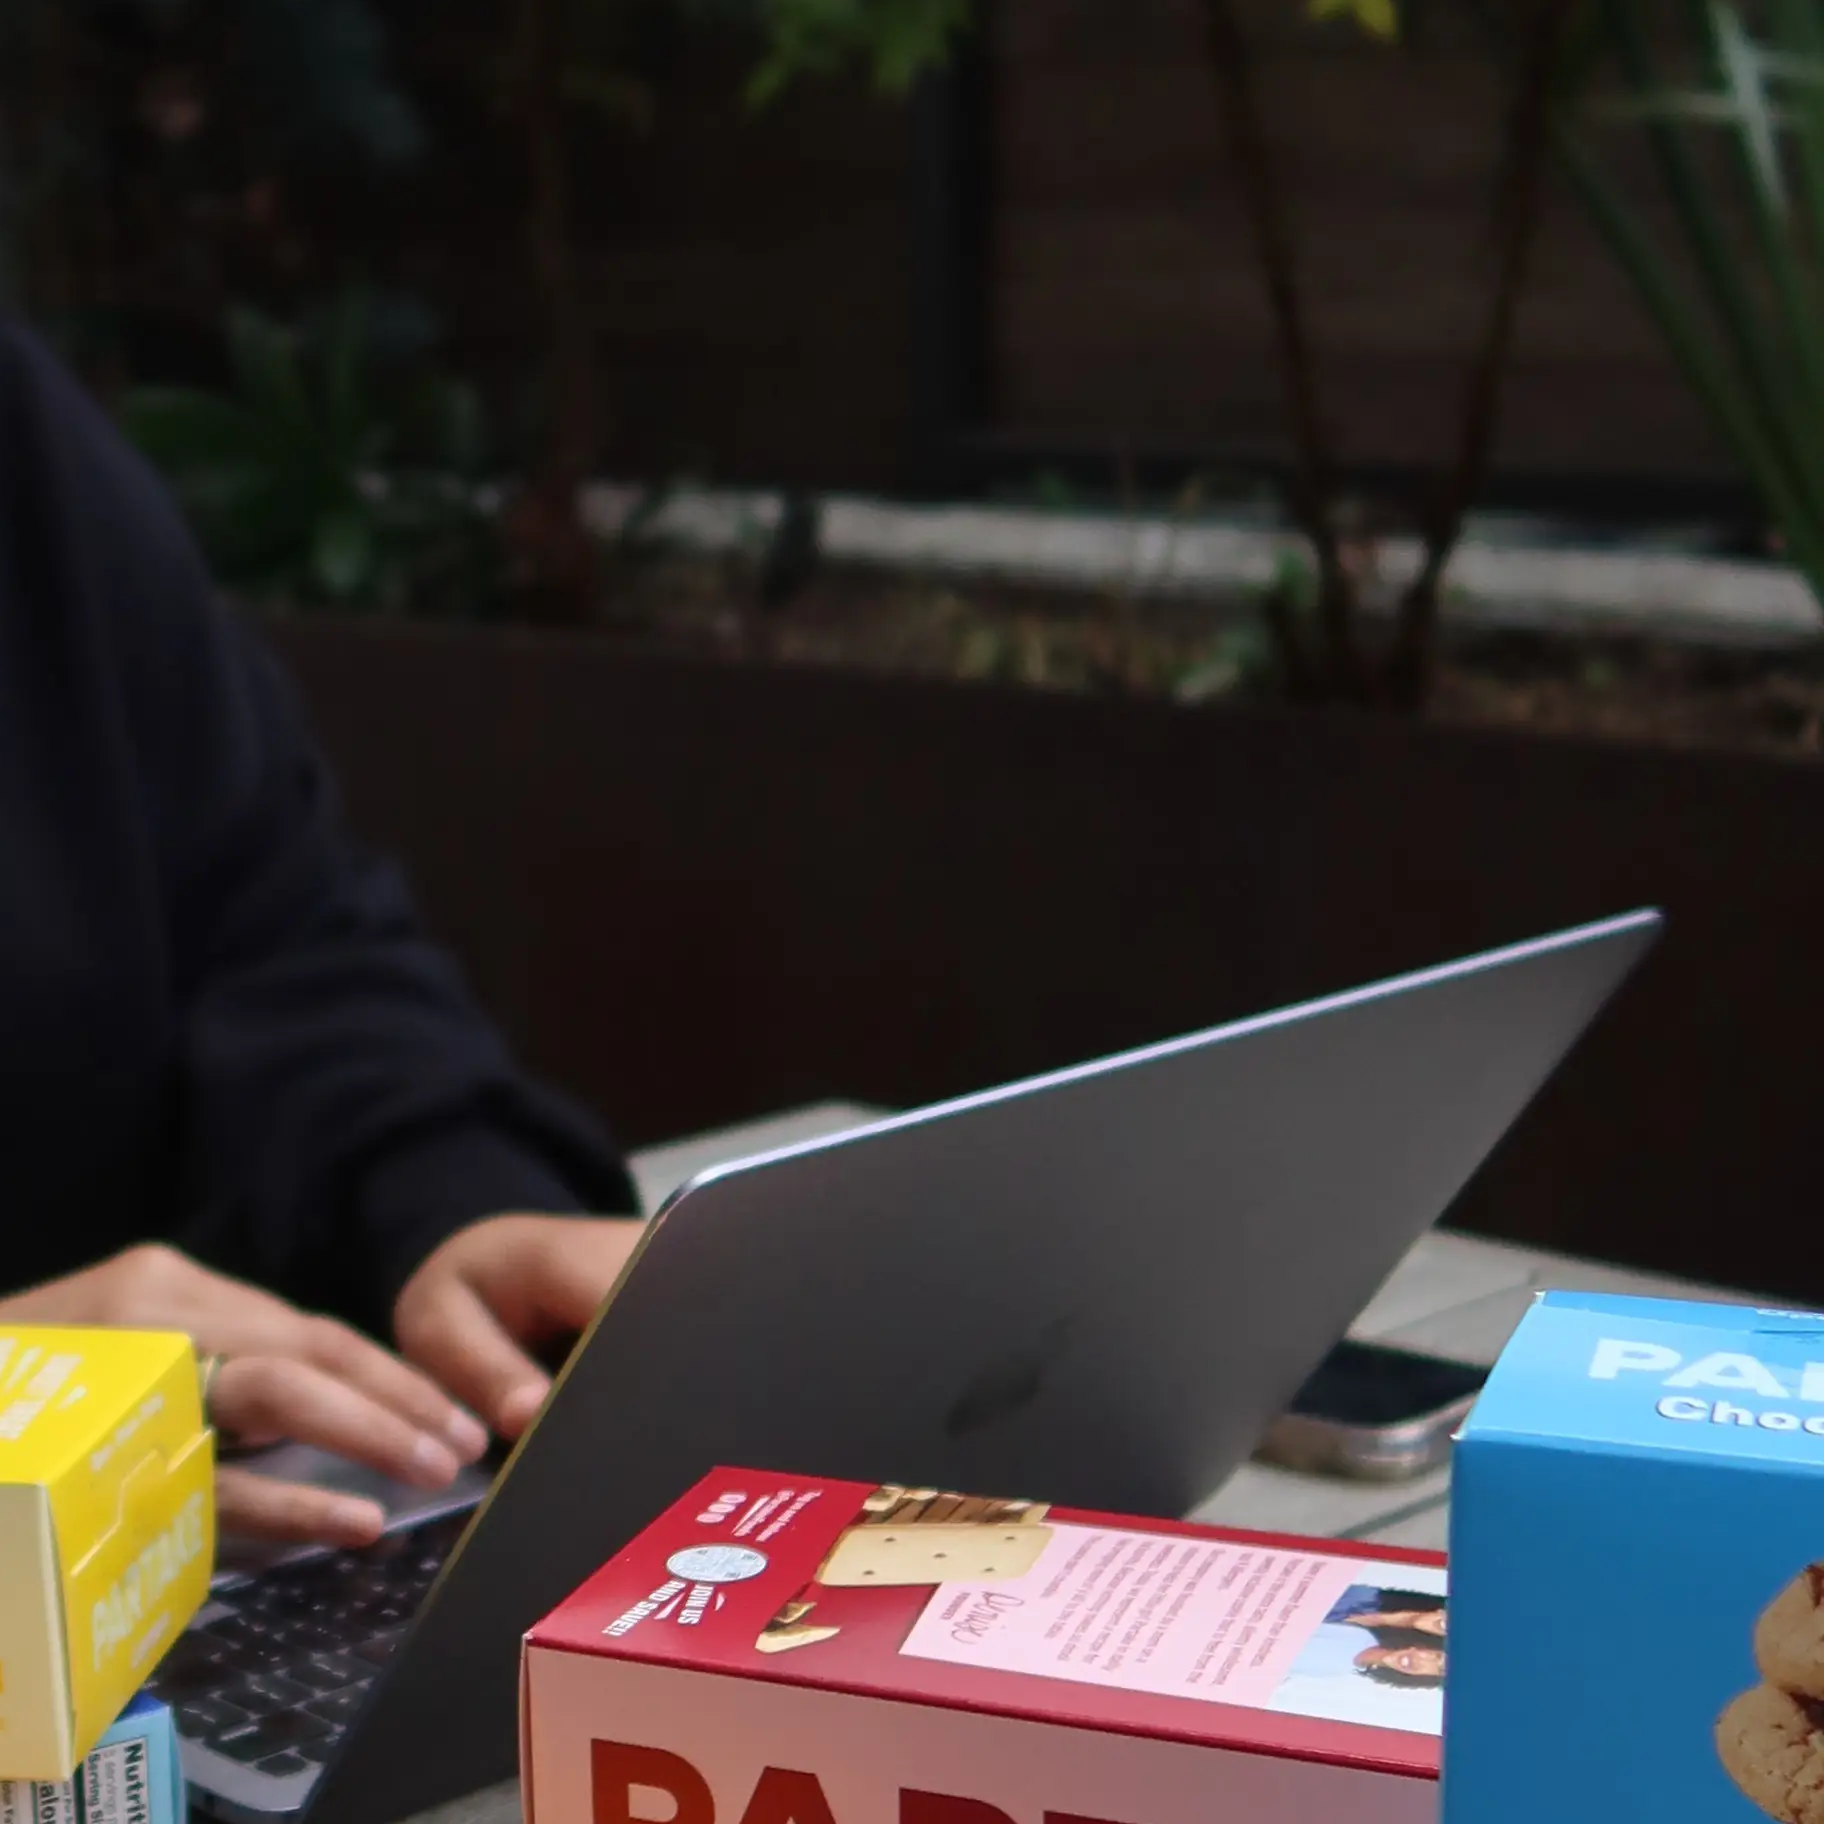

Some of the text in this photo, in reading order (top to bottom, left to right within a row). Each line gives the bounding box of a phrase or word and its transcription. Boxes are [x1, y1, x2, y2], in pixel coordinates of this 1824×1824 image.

[1587, 1337, 1824, 1402] PA
[601, 1579, 687, 1637] AND SAVE!!
[677, 1583, 715, 1625] JOIN US
[88, 1753, 101, 1808] Serving
